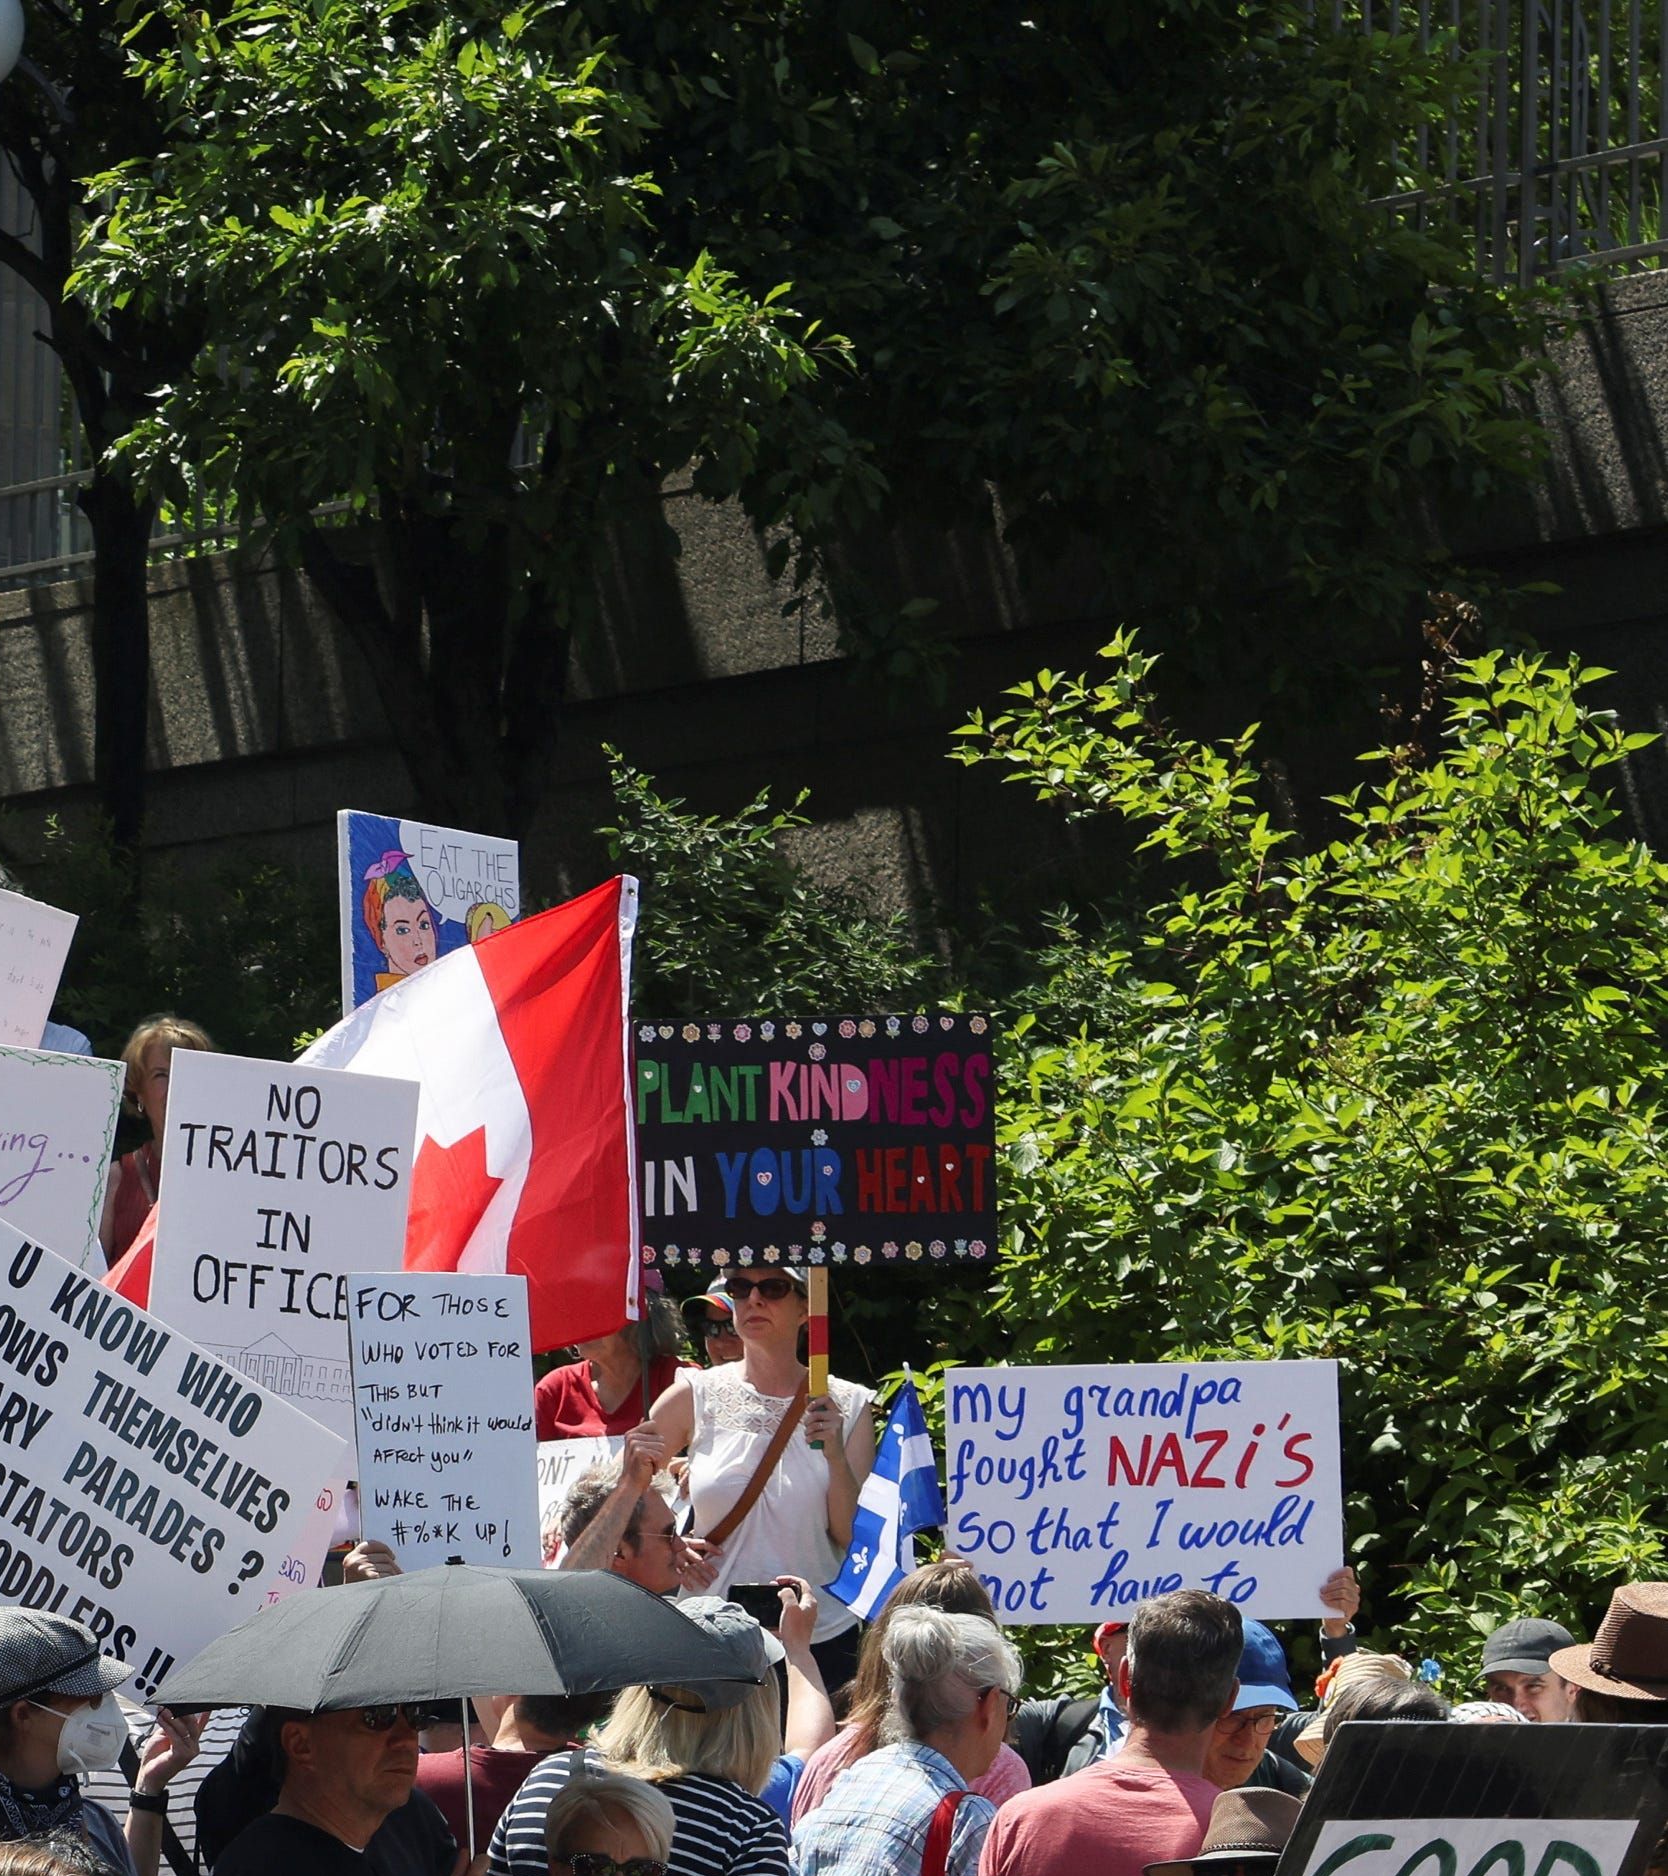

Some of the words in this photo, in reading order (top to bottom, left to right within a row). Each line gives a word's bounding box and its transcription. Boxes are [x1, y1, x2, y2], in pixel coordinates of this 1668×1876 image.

[420, 828, 465, 874] EAT
[470, 846, 514, 884] THE
[424, 870, 519, 912] OLIGARCHS
[267, 1083, 322, 1130] NO
[637, 1064, 763, 1126] PLANT
[769, 1051, 990, 1128] KINDNESS
[179, 1122, 401, 1191] TRAITORS
[644, 1154, 698, 1218] IN
[714, 1147, 844, 1218] YOUR
[855, 1144, 990, 1215] HEART
[255, 1209, 312, 1255] IN
[192, 1253, 350, 1322] OFFICE
[355, 1287, 421, 1322] FOR
[432, 1293, 510, 1317] THOSE
[9, 1241, 44, 1289] U
[54, 1276, 171, 1377] KNOW
[176, 1349, 263, 1437] WHO
[362, 1341, 404, 1364] WHO
[415, 1341, 477, 1361] VOTED
[488, 1341, 521, 1358] FOR
[359, 1385, 400, 1402] THIS
[407, 1384, 443, 1399] BUT
[428, 1409, 462, 1435] think
[464, 1410, 480, 1434] it
[488, 1408, 533, 1432] would
[951, 1381, 1025, 1442] my
[1063, 1372, 1242, 1440] grandpa
[82, 1370, 291, 1533] THEMSELVES
[949, 1436, 1088, 1504] fought
[64, 1440, 226, 1577] PARADES
[374, 1489, 428, 1509] WAKE
[441, 1492, 480, 1511] THE
[1026, 1505, 1120, 1555] that
[1146, 1498, 1173, 1548] I
[1178, 1495, 1314, 1549] would
[475, 1520, 512, 1558] UP!
[982, 1562, 1054, 1612] not
[1090, 1548, 1182, 1607] have
[1200, 1560, 1258, 1602] to
